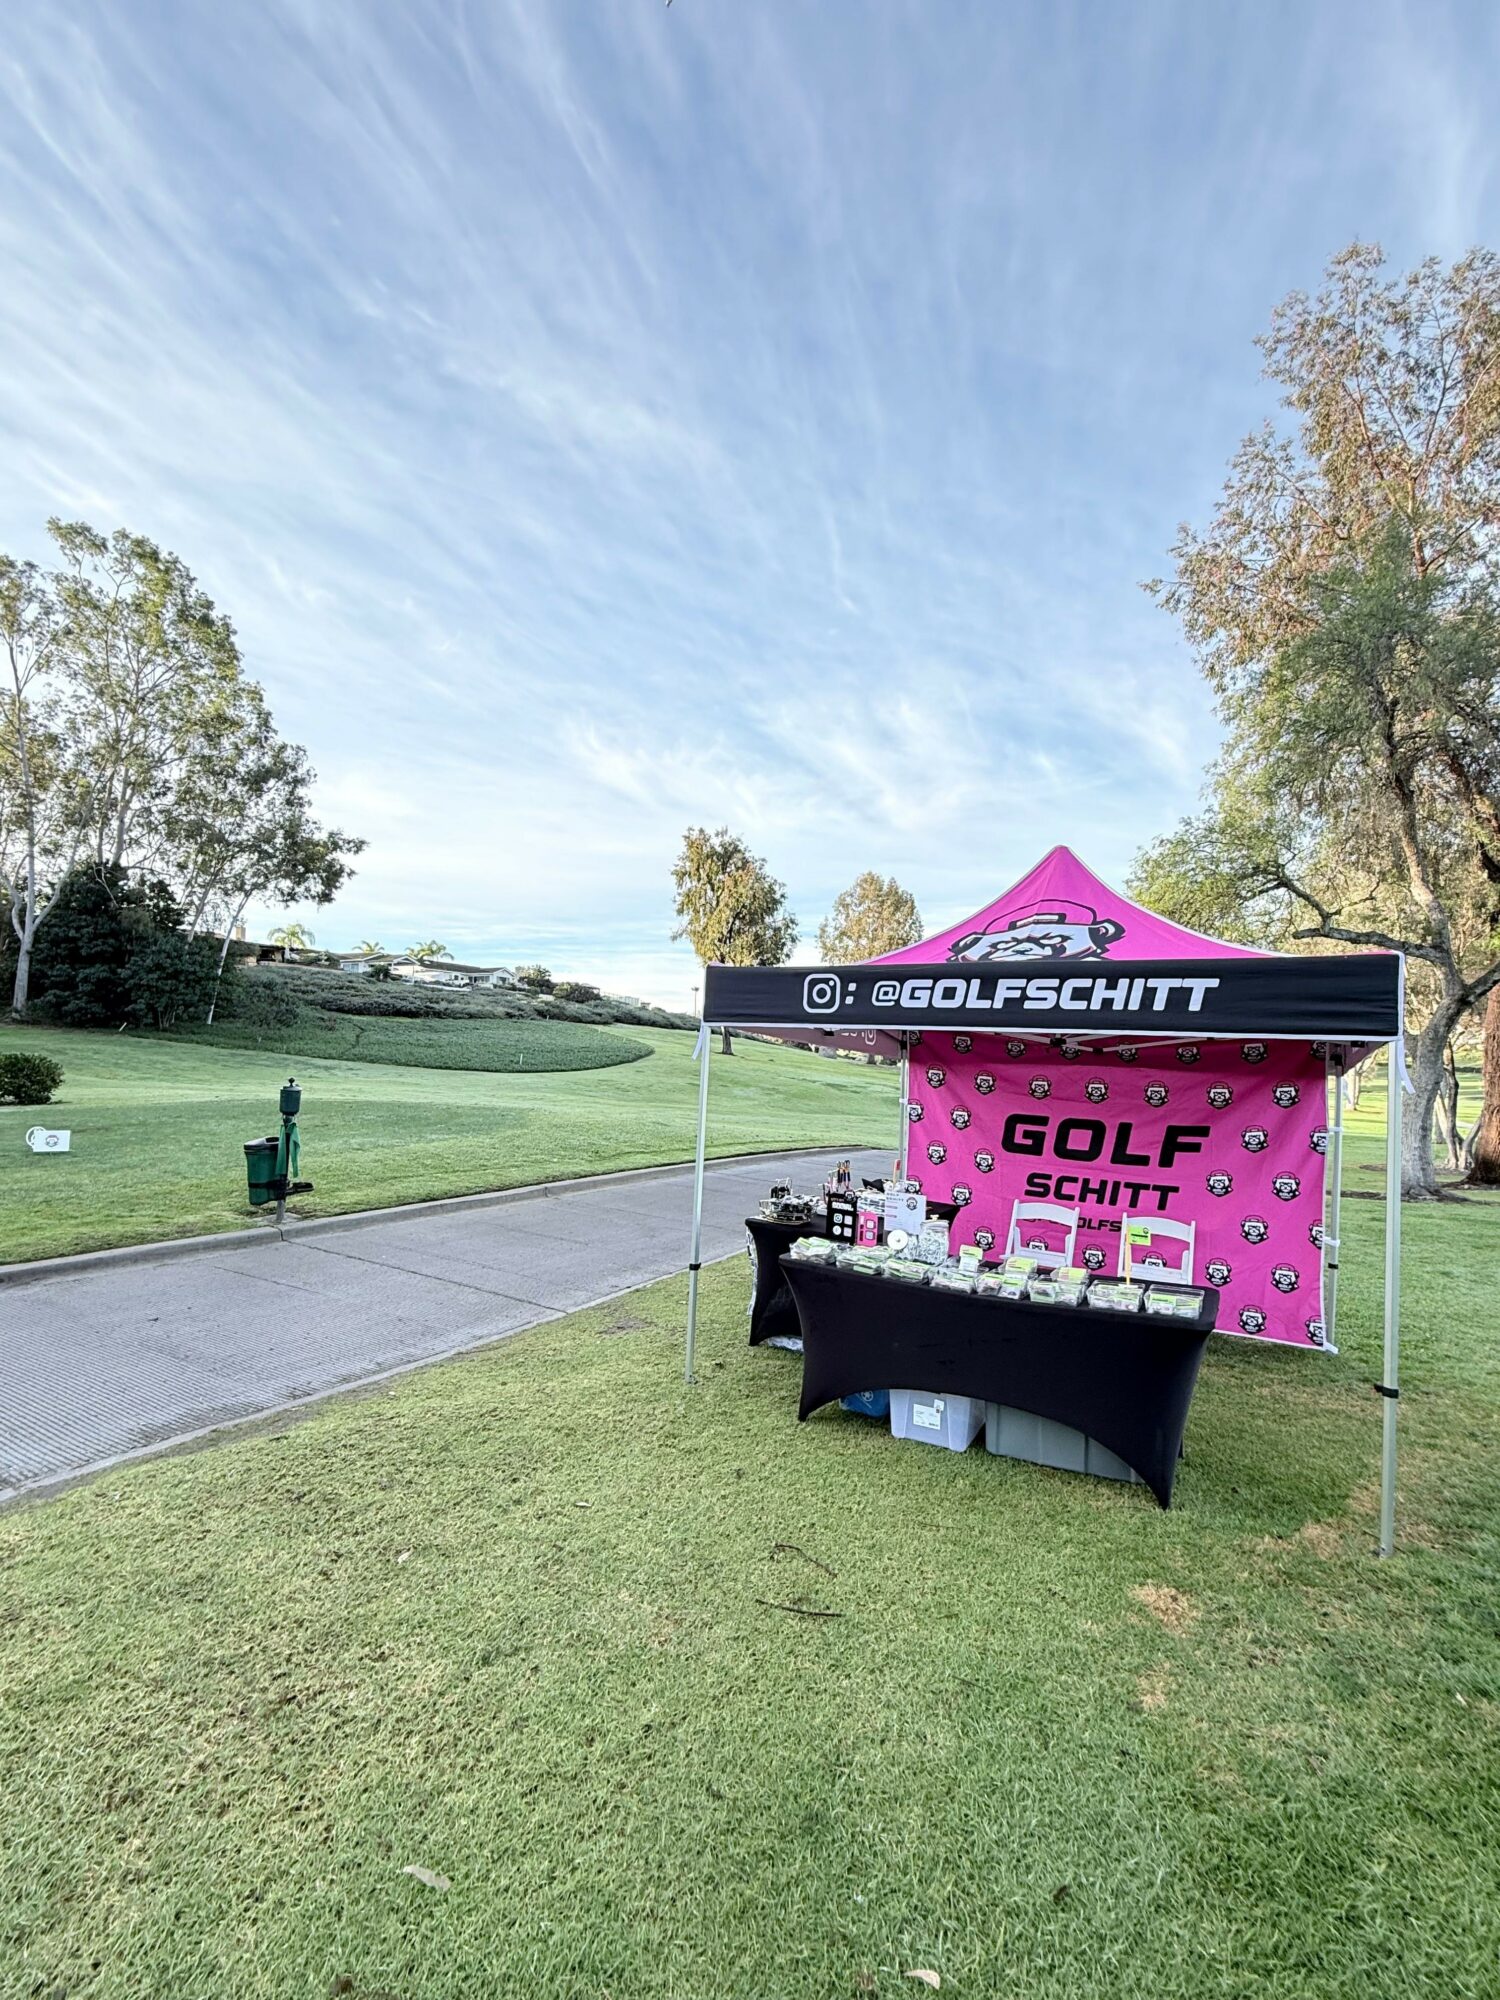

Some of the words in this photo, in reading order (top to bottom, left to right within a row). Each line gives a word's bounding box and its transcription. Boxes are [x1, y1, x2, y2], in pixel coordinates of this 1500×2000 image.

[872, 978, 1219, 1011] @GOLFSCHITT
[1001, 1113, 1211, 1168] GOLF
[1024, 1172, 1180, 1211] SCHITT
